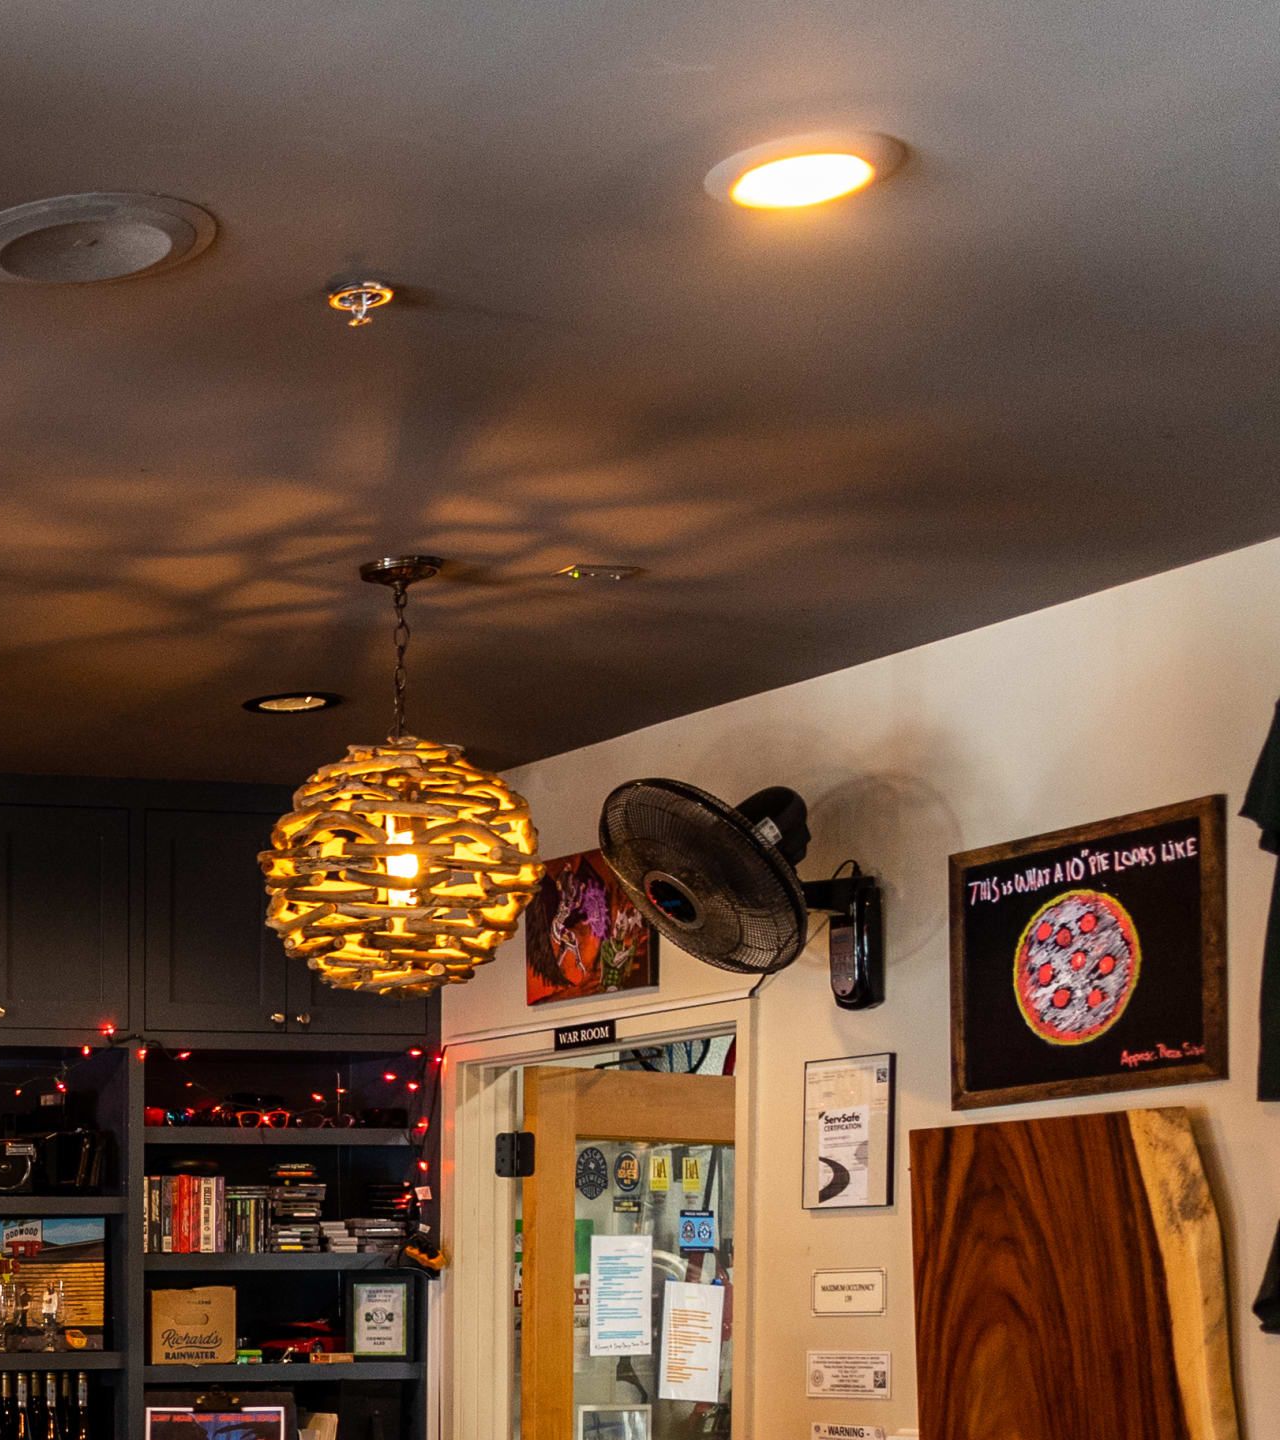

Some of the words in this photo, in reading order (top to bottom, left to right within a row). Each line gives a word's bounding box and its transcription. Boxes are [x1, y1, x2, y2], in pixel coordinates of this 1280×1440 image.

[969, 877, 1000, 905] THIS
[1015, 867, 1050, 893] WHAT
[1053, 863, 1063, 882] A
[1089, 853, 1110, 875] PIE
[1114, 847, 1155, 872] LOOKS
[1162, 838, 1197, 862] LIKE
[559, 1031, 579, 1044] WAR
[581, 1026, 609, 1041] ROOM
[824, 1112, 860, 1124] ServSafe
[824, 1123, 861, 1132] CERTIFICATION
[6, 1228, 38, 1240] ODDWOOD
[161, 1329, 222, 1349] Richard's
[827, 1426, 864, 1437] WARNING
